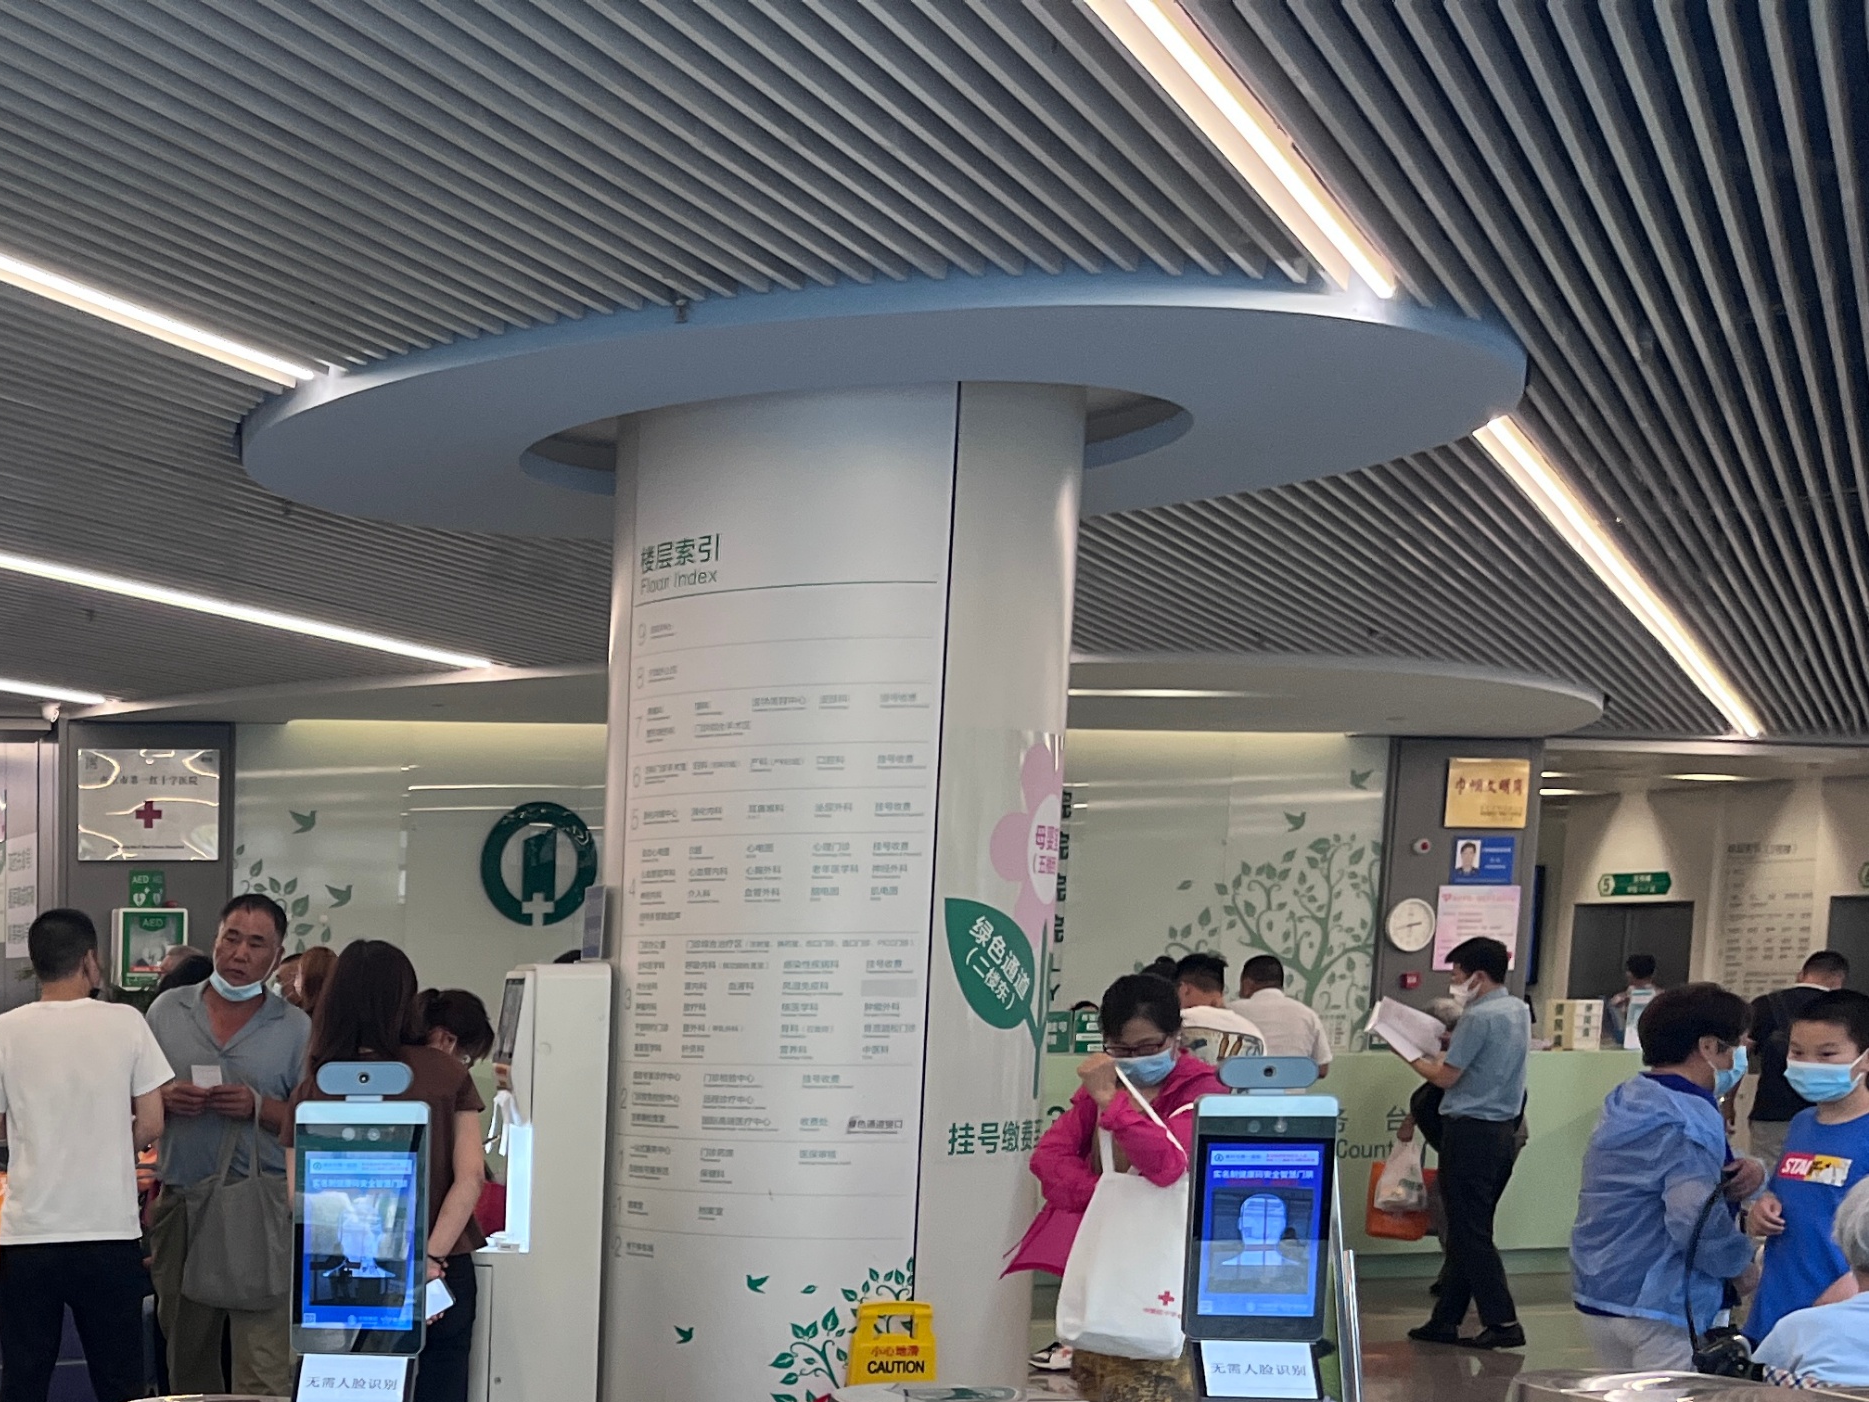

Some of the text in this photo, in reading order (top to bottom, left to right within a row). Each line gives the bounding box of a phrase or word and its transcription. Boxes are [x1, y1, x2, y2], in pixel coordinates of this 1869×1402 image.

[641, 533, 722, 574] 楼层索引
[674, 569, 718, 587] Index
[100, 775, 198, 786] 市第一红十字医院
[1455, 777, 1523, 796] 巾帼文明岗
[132, 875, 149, 884] AED
[142, 918, 164, 927] AED
[969, 915, 1031, 1000] 绿色通道
[1336, 1139, 1394, 1159] Count
[871, 1345, 920, 1357] 小心地滑
[867, 1360, 925, 1374] CAUTION
[1210, 1362, 1307, 1378] 无需人脸识别
[305, 1375, 398, 1392] 无需人脸识别
